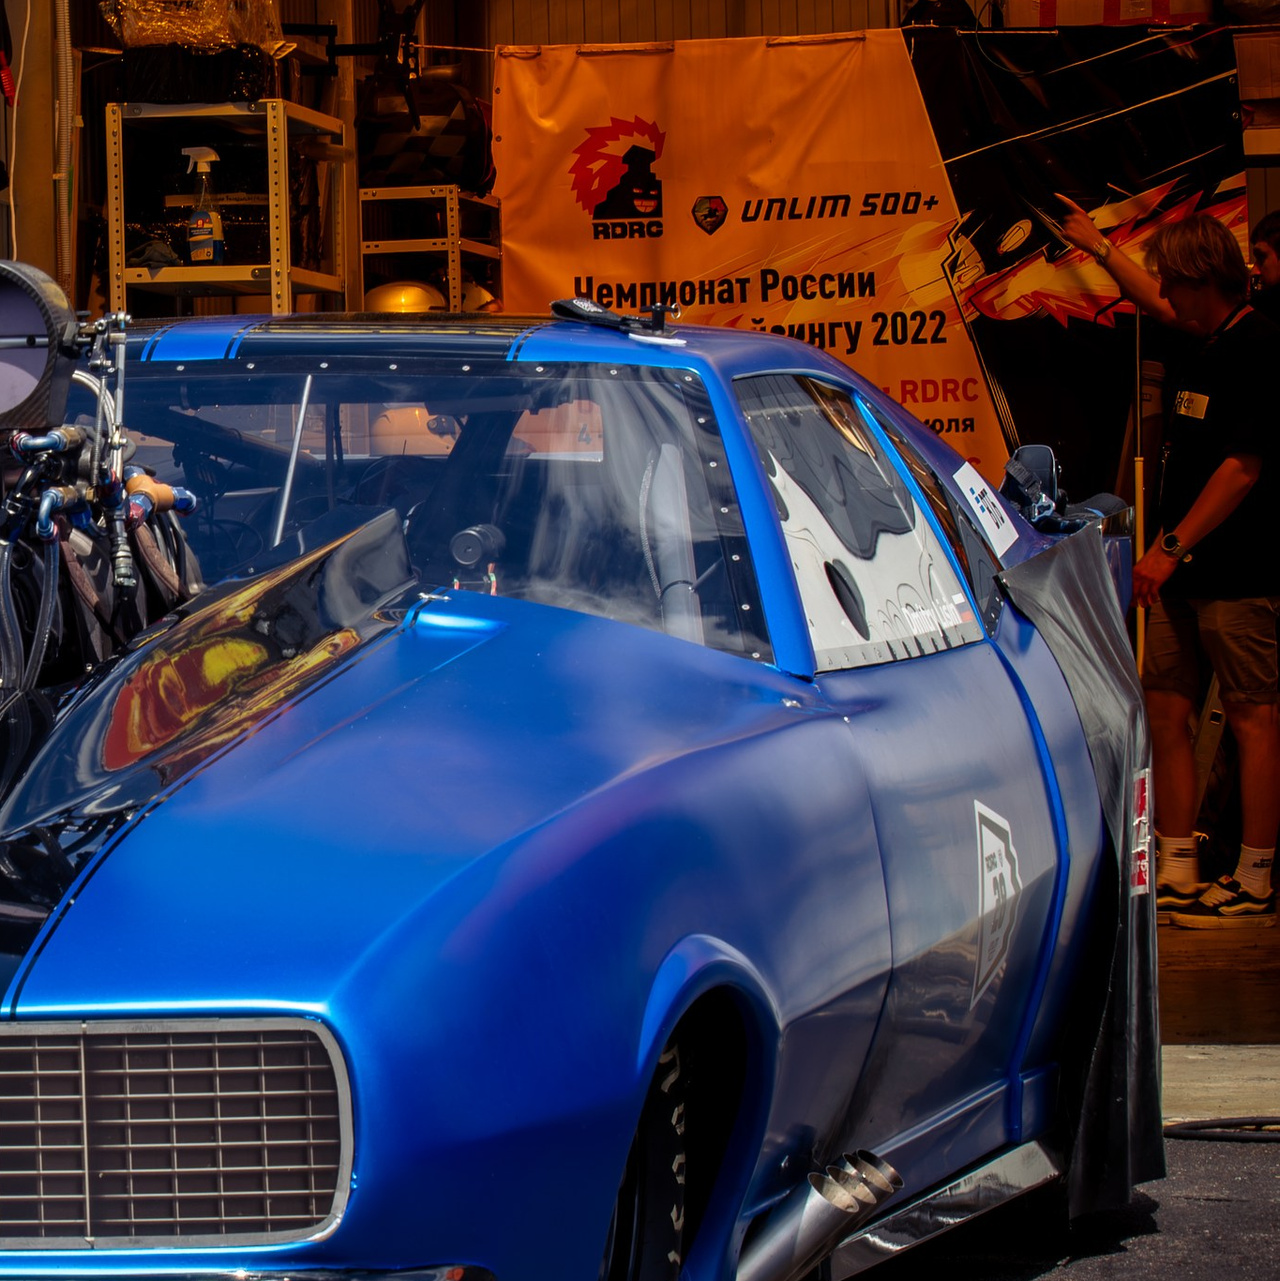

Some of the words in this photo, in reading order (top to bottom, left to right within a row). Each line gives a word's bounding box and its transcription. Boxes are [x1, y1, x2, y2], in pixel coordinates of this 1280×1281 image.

[740, 193, 853, 223] UNLIM
[859, 191, 940, 216] 500+
[592, 220, 663, 240] RDRC
[573, 272, 752, 312] Чемпионат
[759, 266, 877, 302] России
[871, 309, 948, 347] 2022
[900, 377, 979, 404] RDRC
